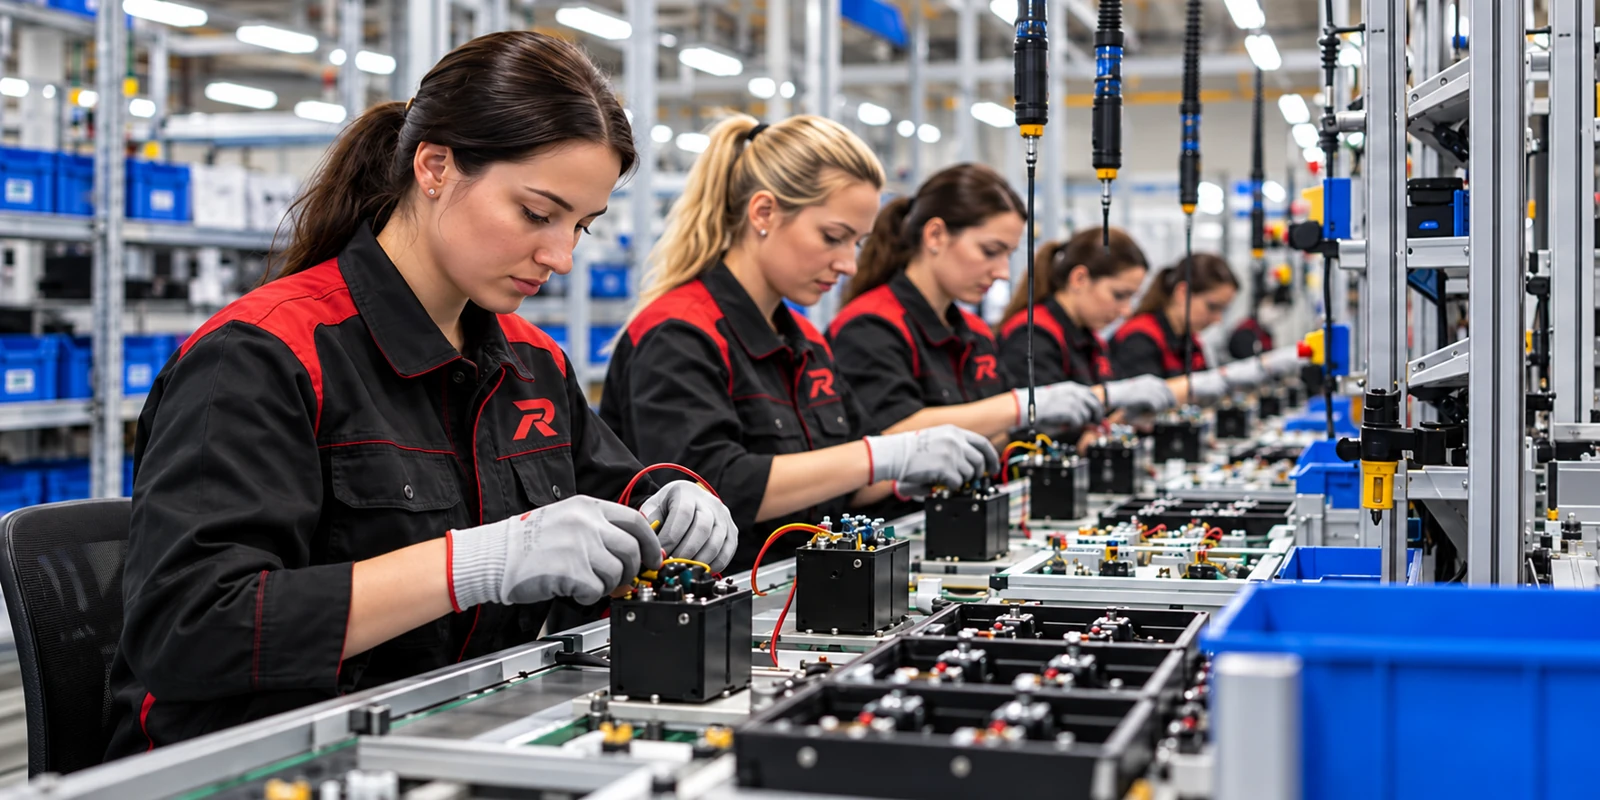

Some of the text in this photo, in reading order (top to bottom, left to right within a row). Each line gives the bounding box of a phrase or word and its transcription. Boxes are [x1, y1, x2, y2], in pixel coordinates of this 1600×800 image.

[974, 354, 998, 381] R
[807, 368, 836, 398] R
[512, 398, 558, 440] R
